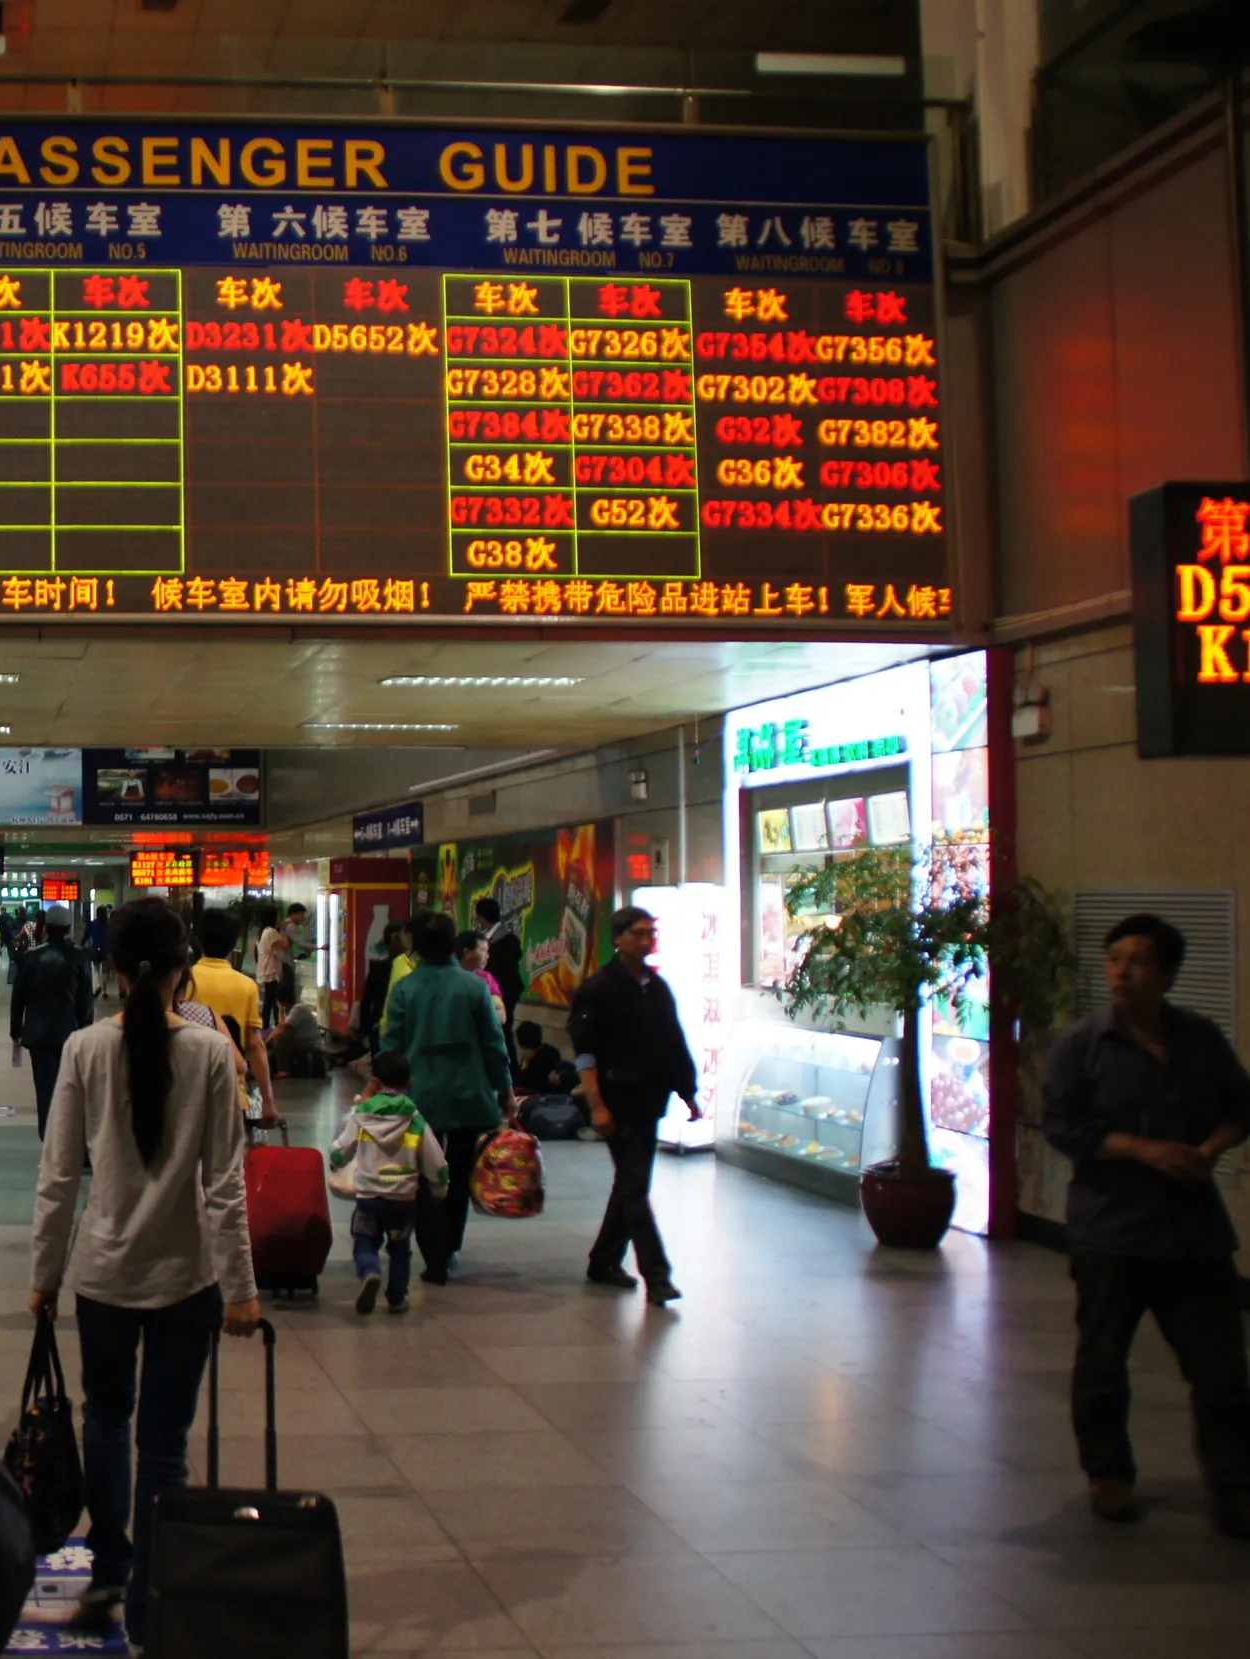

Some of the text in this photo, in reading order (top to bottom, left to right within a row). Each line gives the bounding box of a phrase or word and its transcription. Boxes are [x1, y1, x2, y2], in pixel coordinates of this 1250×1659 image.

[439, 142, 655, 195] GUIDE
[217, 204, 431, 240] 第六候车室
[486, 208, 692, 247] 第七候车室
[717, 213, 919, 253] 第八候车室
[108, 242, 146, 260] NO.5
[233, 243, 408, 262] WAITINGROOM NO.6
[503, 248, 675, 268] WAITINGROOM NO.7
[736, 254, 845, 273] WAITINGROOM
[83, 276, 150, 308] 车次
[217, 276, 410, 311] 车次 车次
[475, 281, 662, 317] 车次 车次
[724, 287, 908, 324] 车次 车次
[53, 318, 179, 352] K1219次
[186, 319, 438, 355] D3231次 D5652次
[447, 324, 691, 359] G7324次 G7326次
[816, 334, 936, 366] G7356次
[61, 360, 170, 394] K655次
[187, 362, 314, 395] D3111次
[448, 367, 693, 402] G7328次 G7362次
[698, 372, 939, 408] G7302次 G7308次
[449, 409, 694, 444] G7384次 G7338次
[716, 414, 939, 450] G32次 G7382次
[465, 451, 696, 486] G34次 G7304次
[718, 456, 941, 491] G36次 G7306次
[451, 494, 679, 528] G7332次 G52次
[702, 499, 943, 534] G7334次 G7336次
[468, 538, 557, 570] G38次
[1176, 564, 1250, 622] D5
